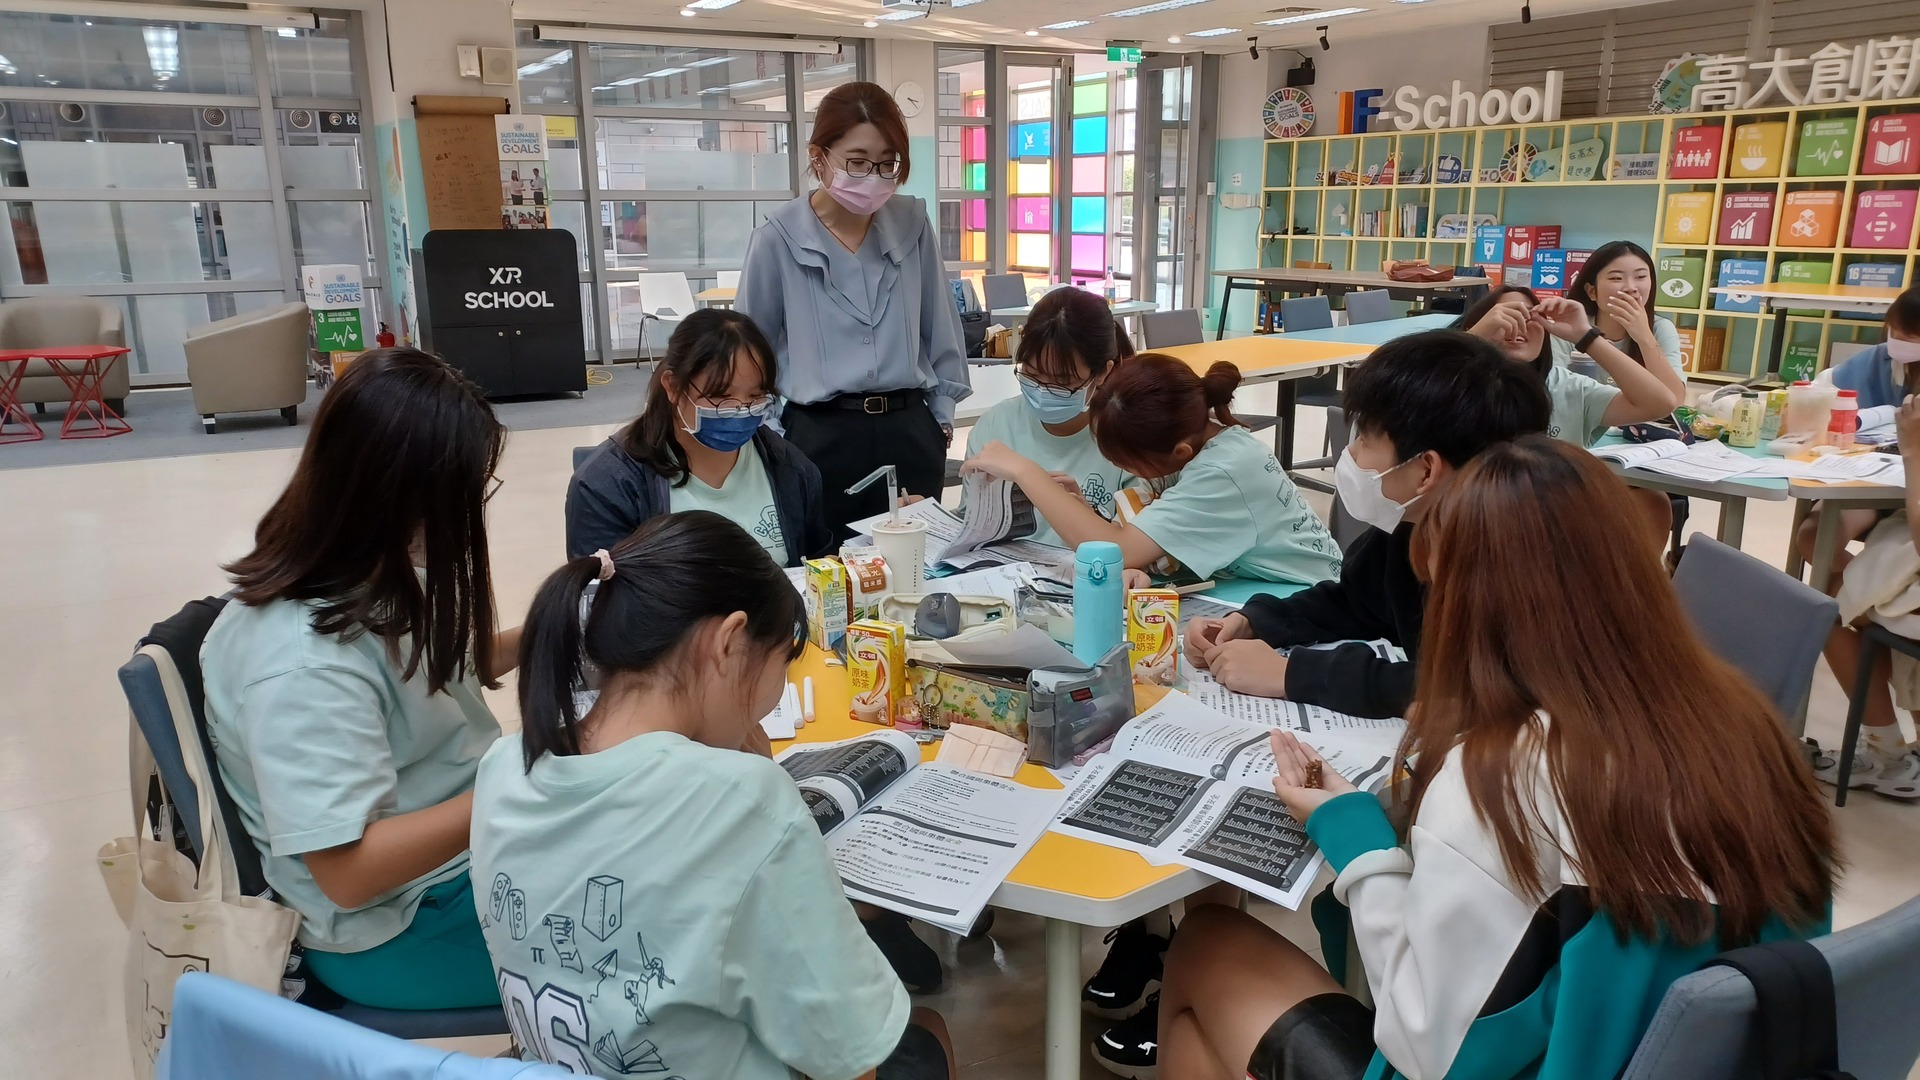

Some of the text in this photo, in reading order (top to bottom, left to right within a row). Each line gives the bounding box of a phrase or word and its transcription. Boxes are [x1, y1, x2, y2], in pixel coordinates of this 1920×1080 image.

[1805, 123, 1812, 137] 3
[1872, 120, 1879, 133] 4
[1679, 131, 1684, 142] 1
[1738, 128, 1744, 140] 2
[502, 144, 541, 154] GOALS
[1725, 196, 1732, 209] 8
[1786, 193, 1795, 205] 9
[1860, 195, 1872, 208] 10
[1508, 227, 1513, 238] 4
[1536, 253, 1543, 263] 14
[1566, 252, 1572, 263] 8
[1660, 259, 1669, 271] 13
[1722, 262, 1732, 274] 14
[1781, 264, 1792, 277] 15
[488, 266, 522, 285] XR
[1848, 267, 1860, 280] 16
[325, 293, 362, 304] GOALS
[464, 290, 555, 309] SCHOOL
[317, 312, 325, 323] 3
[1790, 346, 1796, 356] 3
[1137, 633, 1156, 642] 原味
[1136, 642, 1156, 652] 奶茶
[851, 667, 870, 679] 原味
[852, 677, 870, 689] 奶茶
